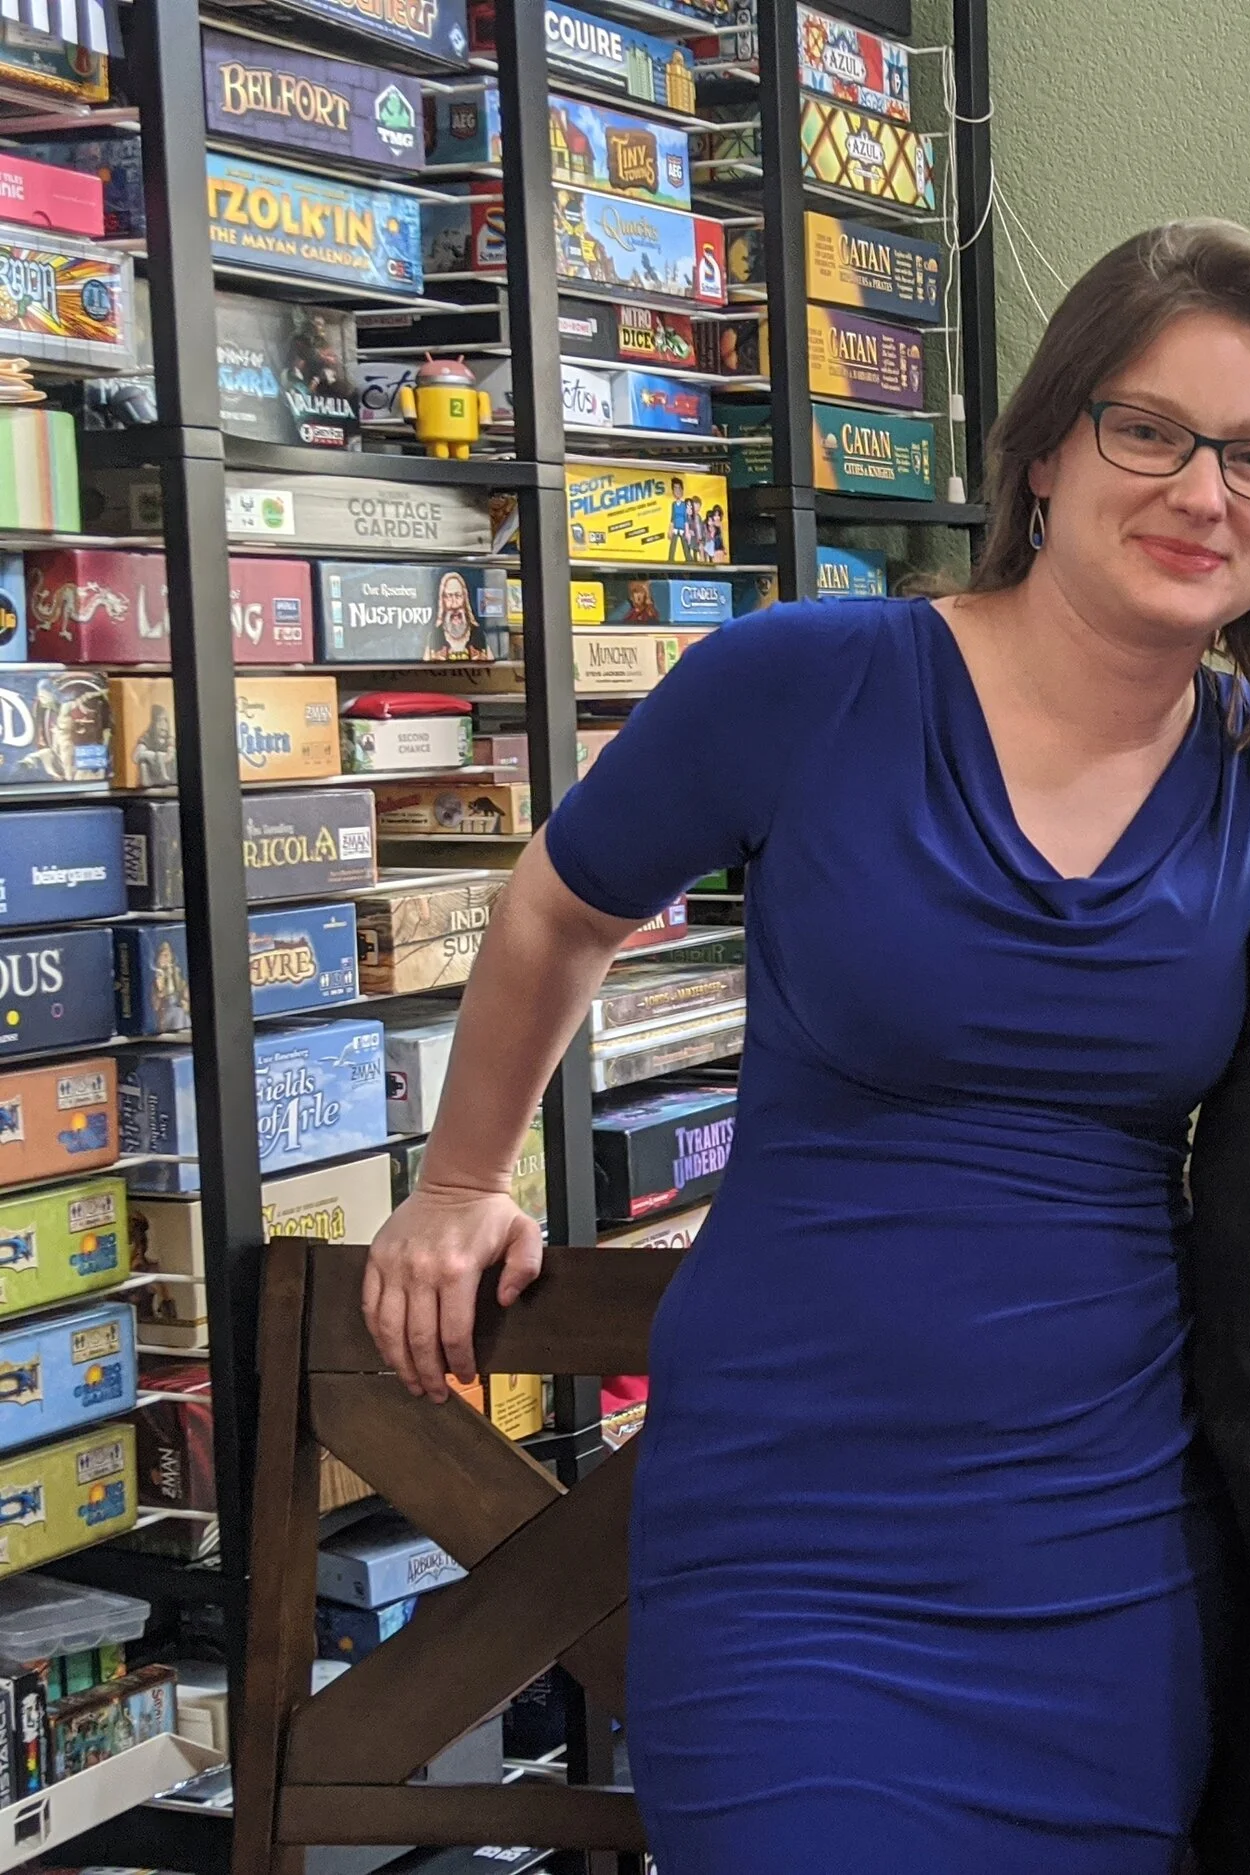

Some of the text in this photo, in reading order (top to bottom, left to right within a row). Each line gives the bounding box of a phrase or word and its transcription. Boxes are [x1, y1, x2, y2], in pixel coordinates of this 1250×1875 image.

[544, 10, 623, 62] CQUIRE
[828, 53, 860, 77] AZUL
[219, 62, 350, 131] BELFORT
[452, 112, 476, 129] AEG
[377, 126, 414, 147] TMG
[611, 133, 645, 180] TINY
[853, 142, 879, 160] AZUL
[668, 162, 682, 179] AEG
[208, 177, 374, 249] TZOLK'IN
[210, 225, 237, 245] THE
[241, 234, 297, 256] MAYAN
[838, 233, 891, 276] CATAN
[621, 306, 652, 329] NITRO
[622, 328, 652, 348] DICE
[828, 327, 878, 365] CATAN
[285, 390, 356, 419] VALHALLA
[452, 401, 463, 416] 2
[842, 423, 892, 459] CATAN
[569, 473, 615, 498] SCOTT
[348, 498, 443, 522] COTTAGE
[353, 517, 439, 541] GARDEN
[589, 642, 638, 669] MUNCHKIN
[243, 825, 338, 869] RICOLA
[255, 1067, 315, 1102] ields
